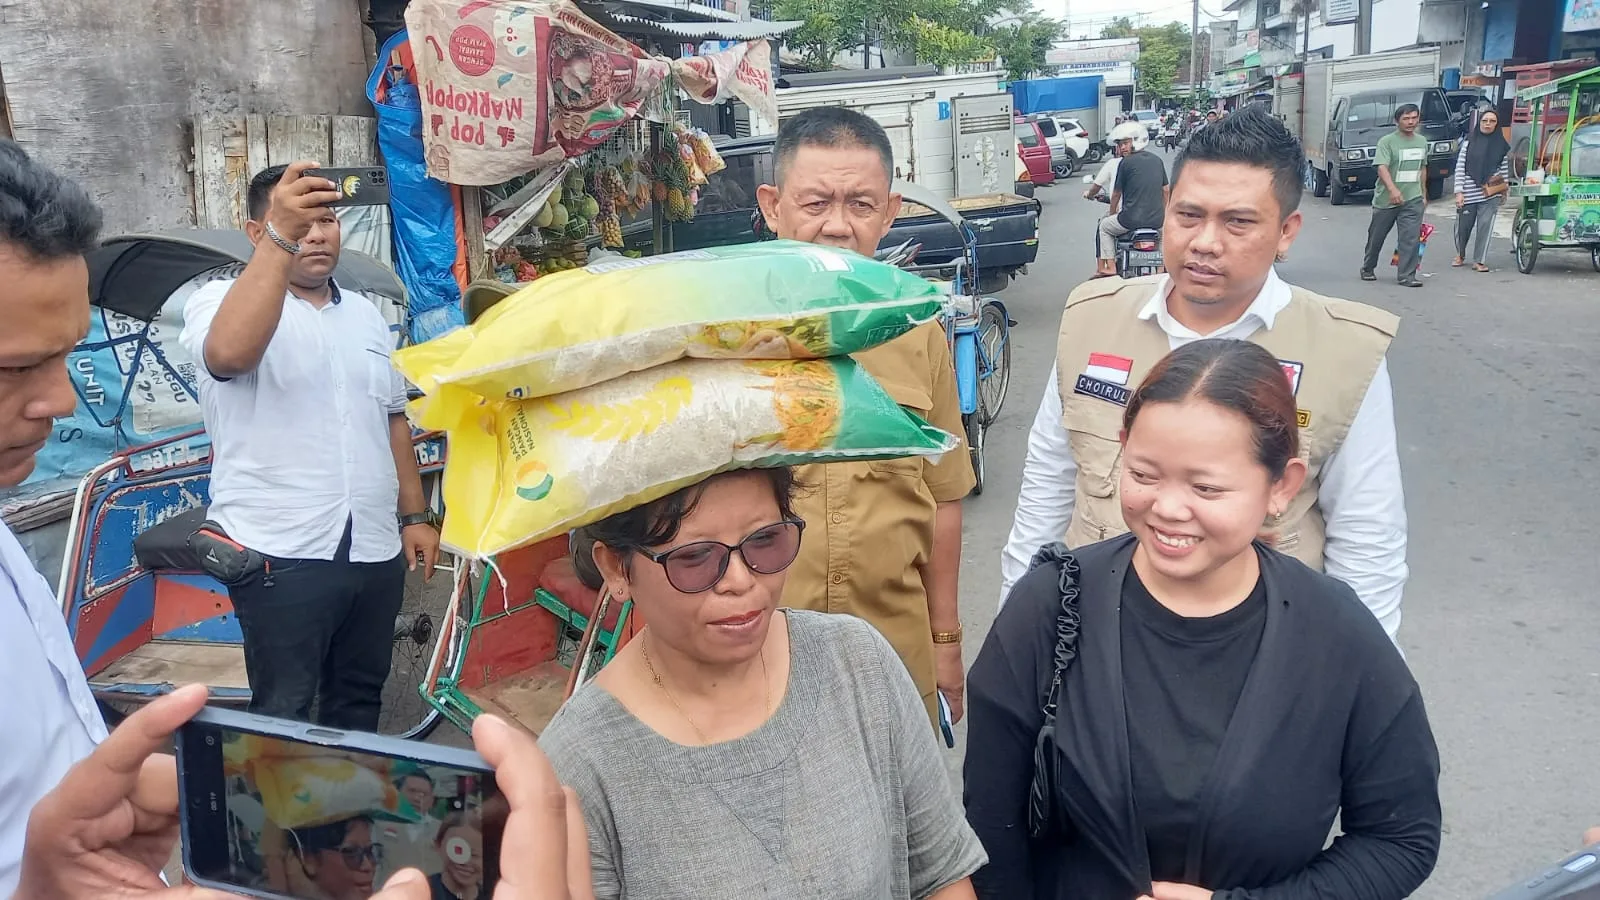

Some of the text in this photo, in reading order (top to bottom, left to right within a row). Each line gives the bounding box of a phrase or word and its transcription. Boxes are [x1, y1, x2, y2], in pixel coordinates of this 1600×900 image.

[450, 115, 485, 146] POP
[76, 358, 105, 406] UNIT
[1078, 377, 1127, 403] CHOIRUL
[510, 417, 528, 456] PANGAN
[516, 404, 535, 451] NASIONAL
[506, 429, 521, 463] BADAN
